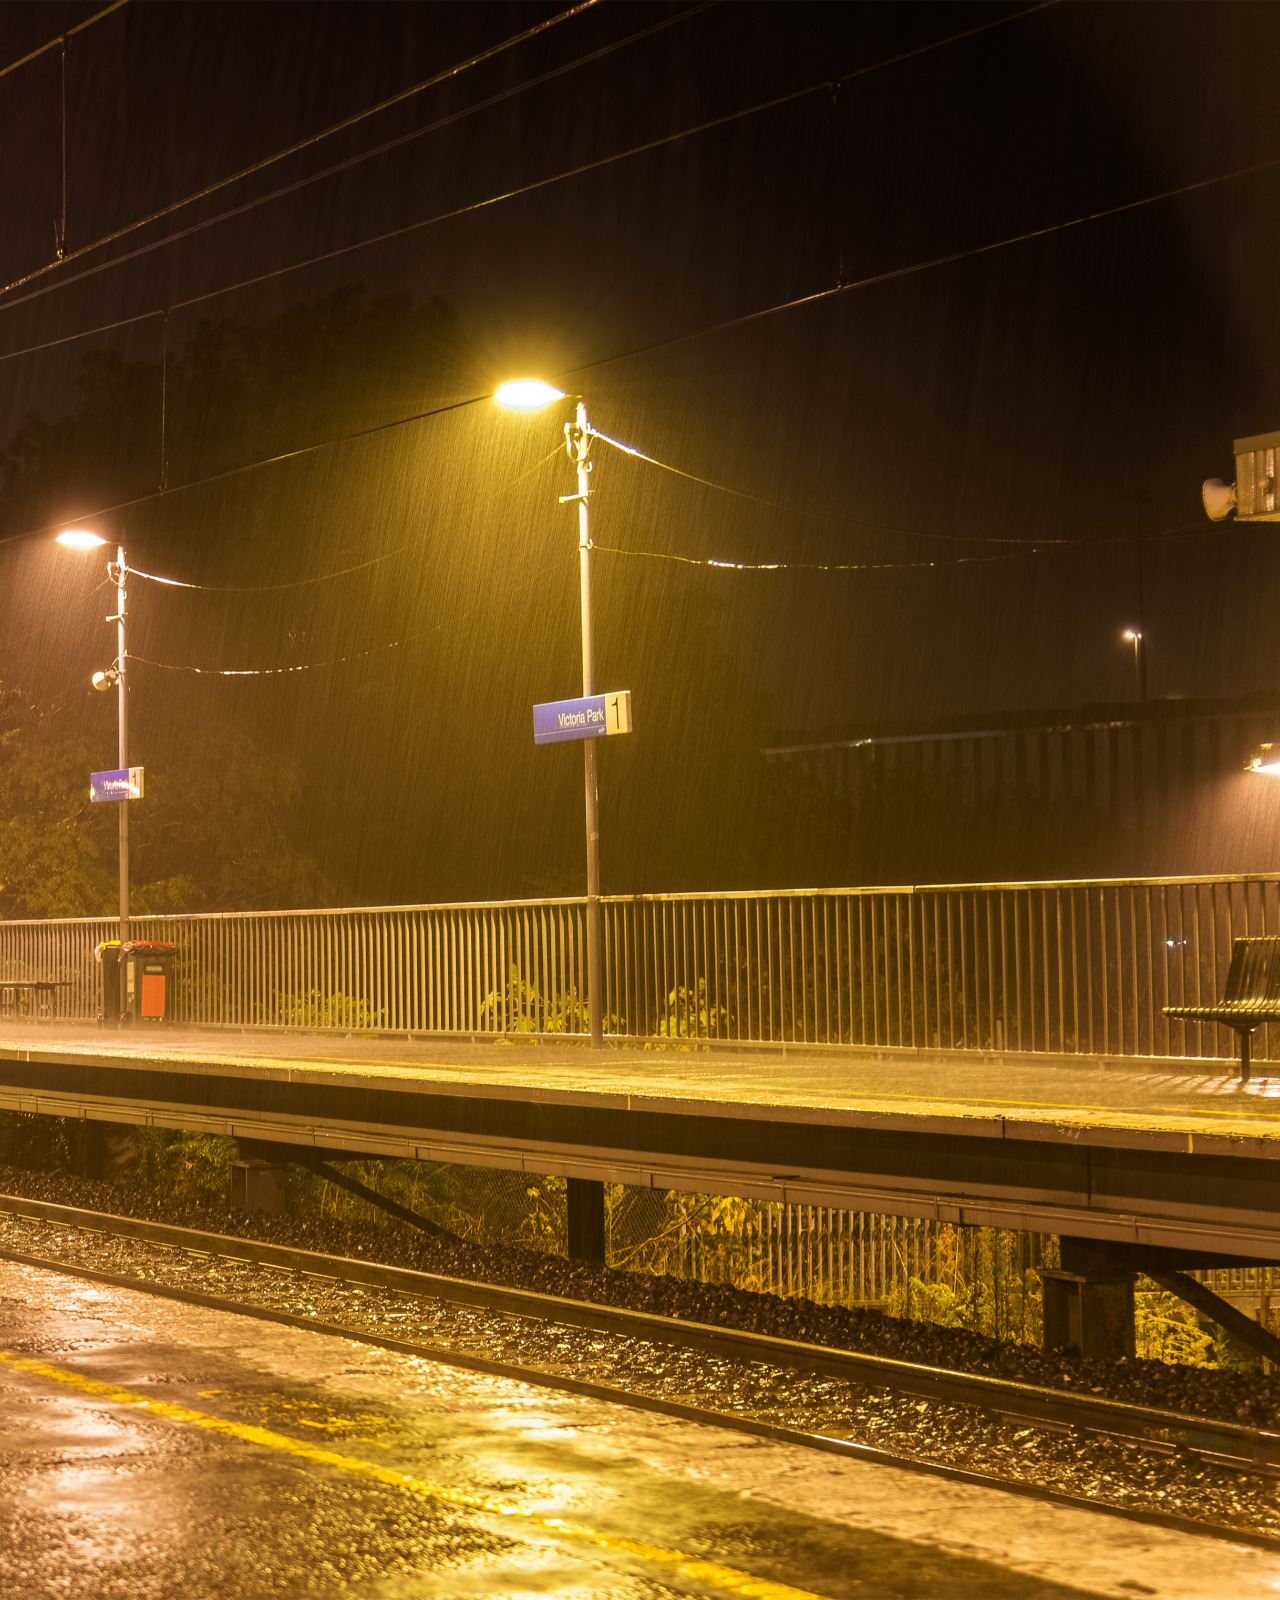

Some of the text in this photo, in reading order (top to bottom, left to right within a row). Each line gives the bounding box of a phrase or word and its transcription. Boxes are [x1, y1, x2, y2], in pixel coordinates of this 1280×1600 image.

[558, 708, 604, 727] Victoria Park
[612, 697, 619, 729] 1
